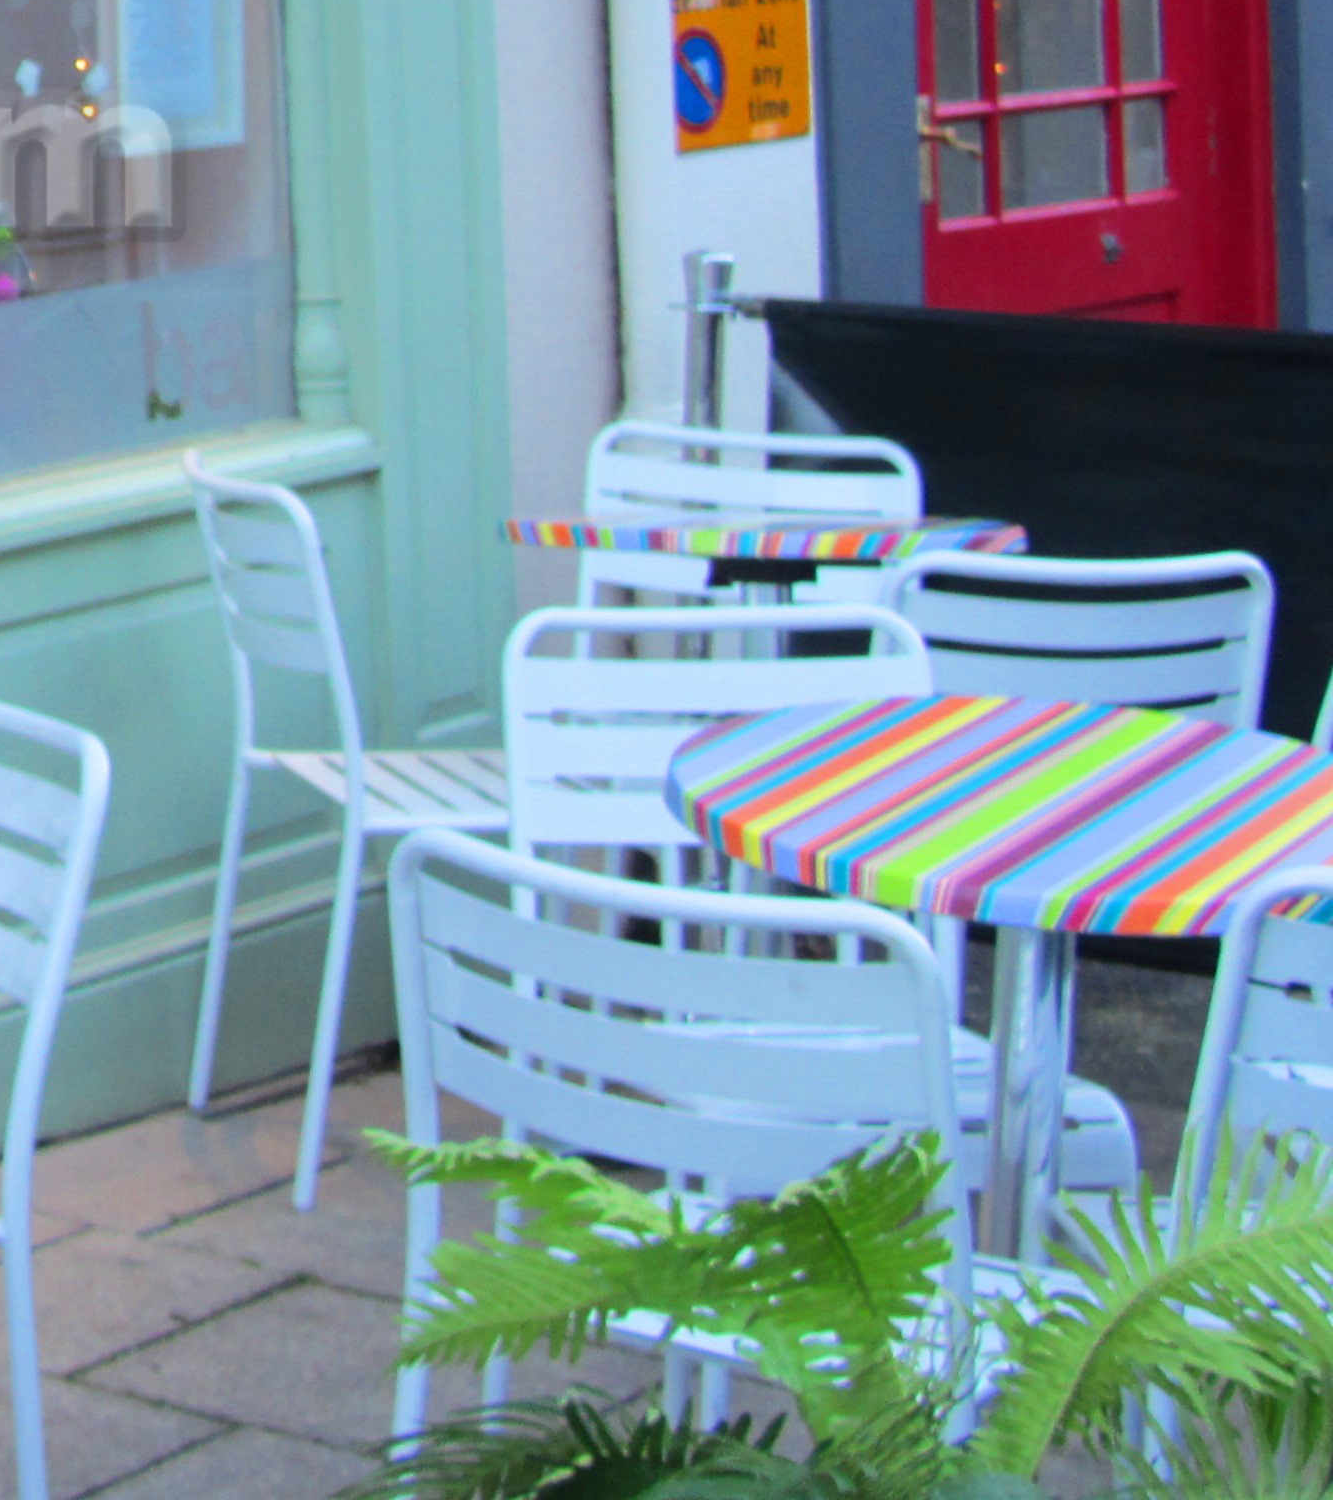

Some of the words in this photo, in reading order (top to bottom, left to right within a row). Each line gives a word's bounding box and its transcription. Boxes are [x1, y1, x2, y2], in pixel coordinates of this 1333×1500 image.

[757, 23, 777, 49] At
[752, 65, 783, 88] any
[748, 95, 791, 122] time
